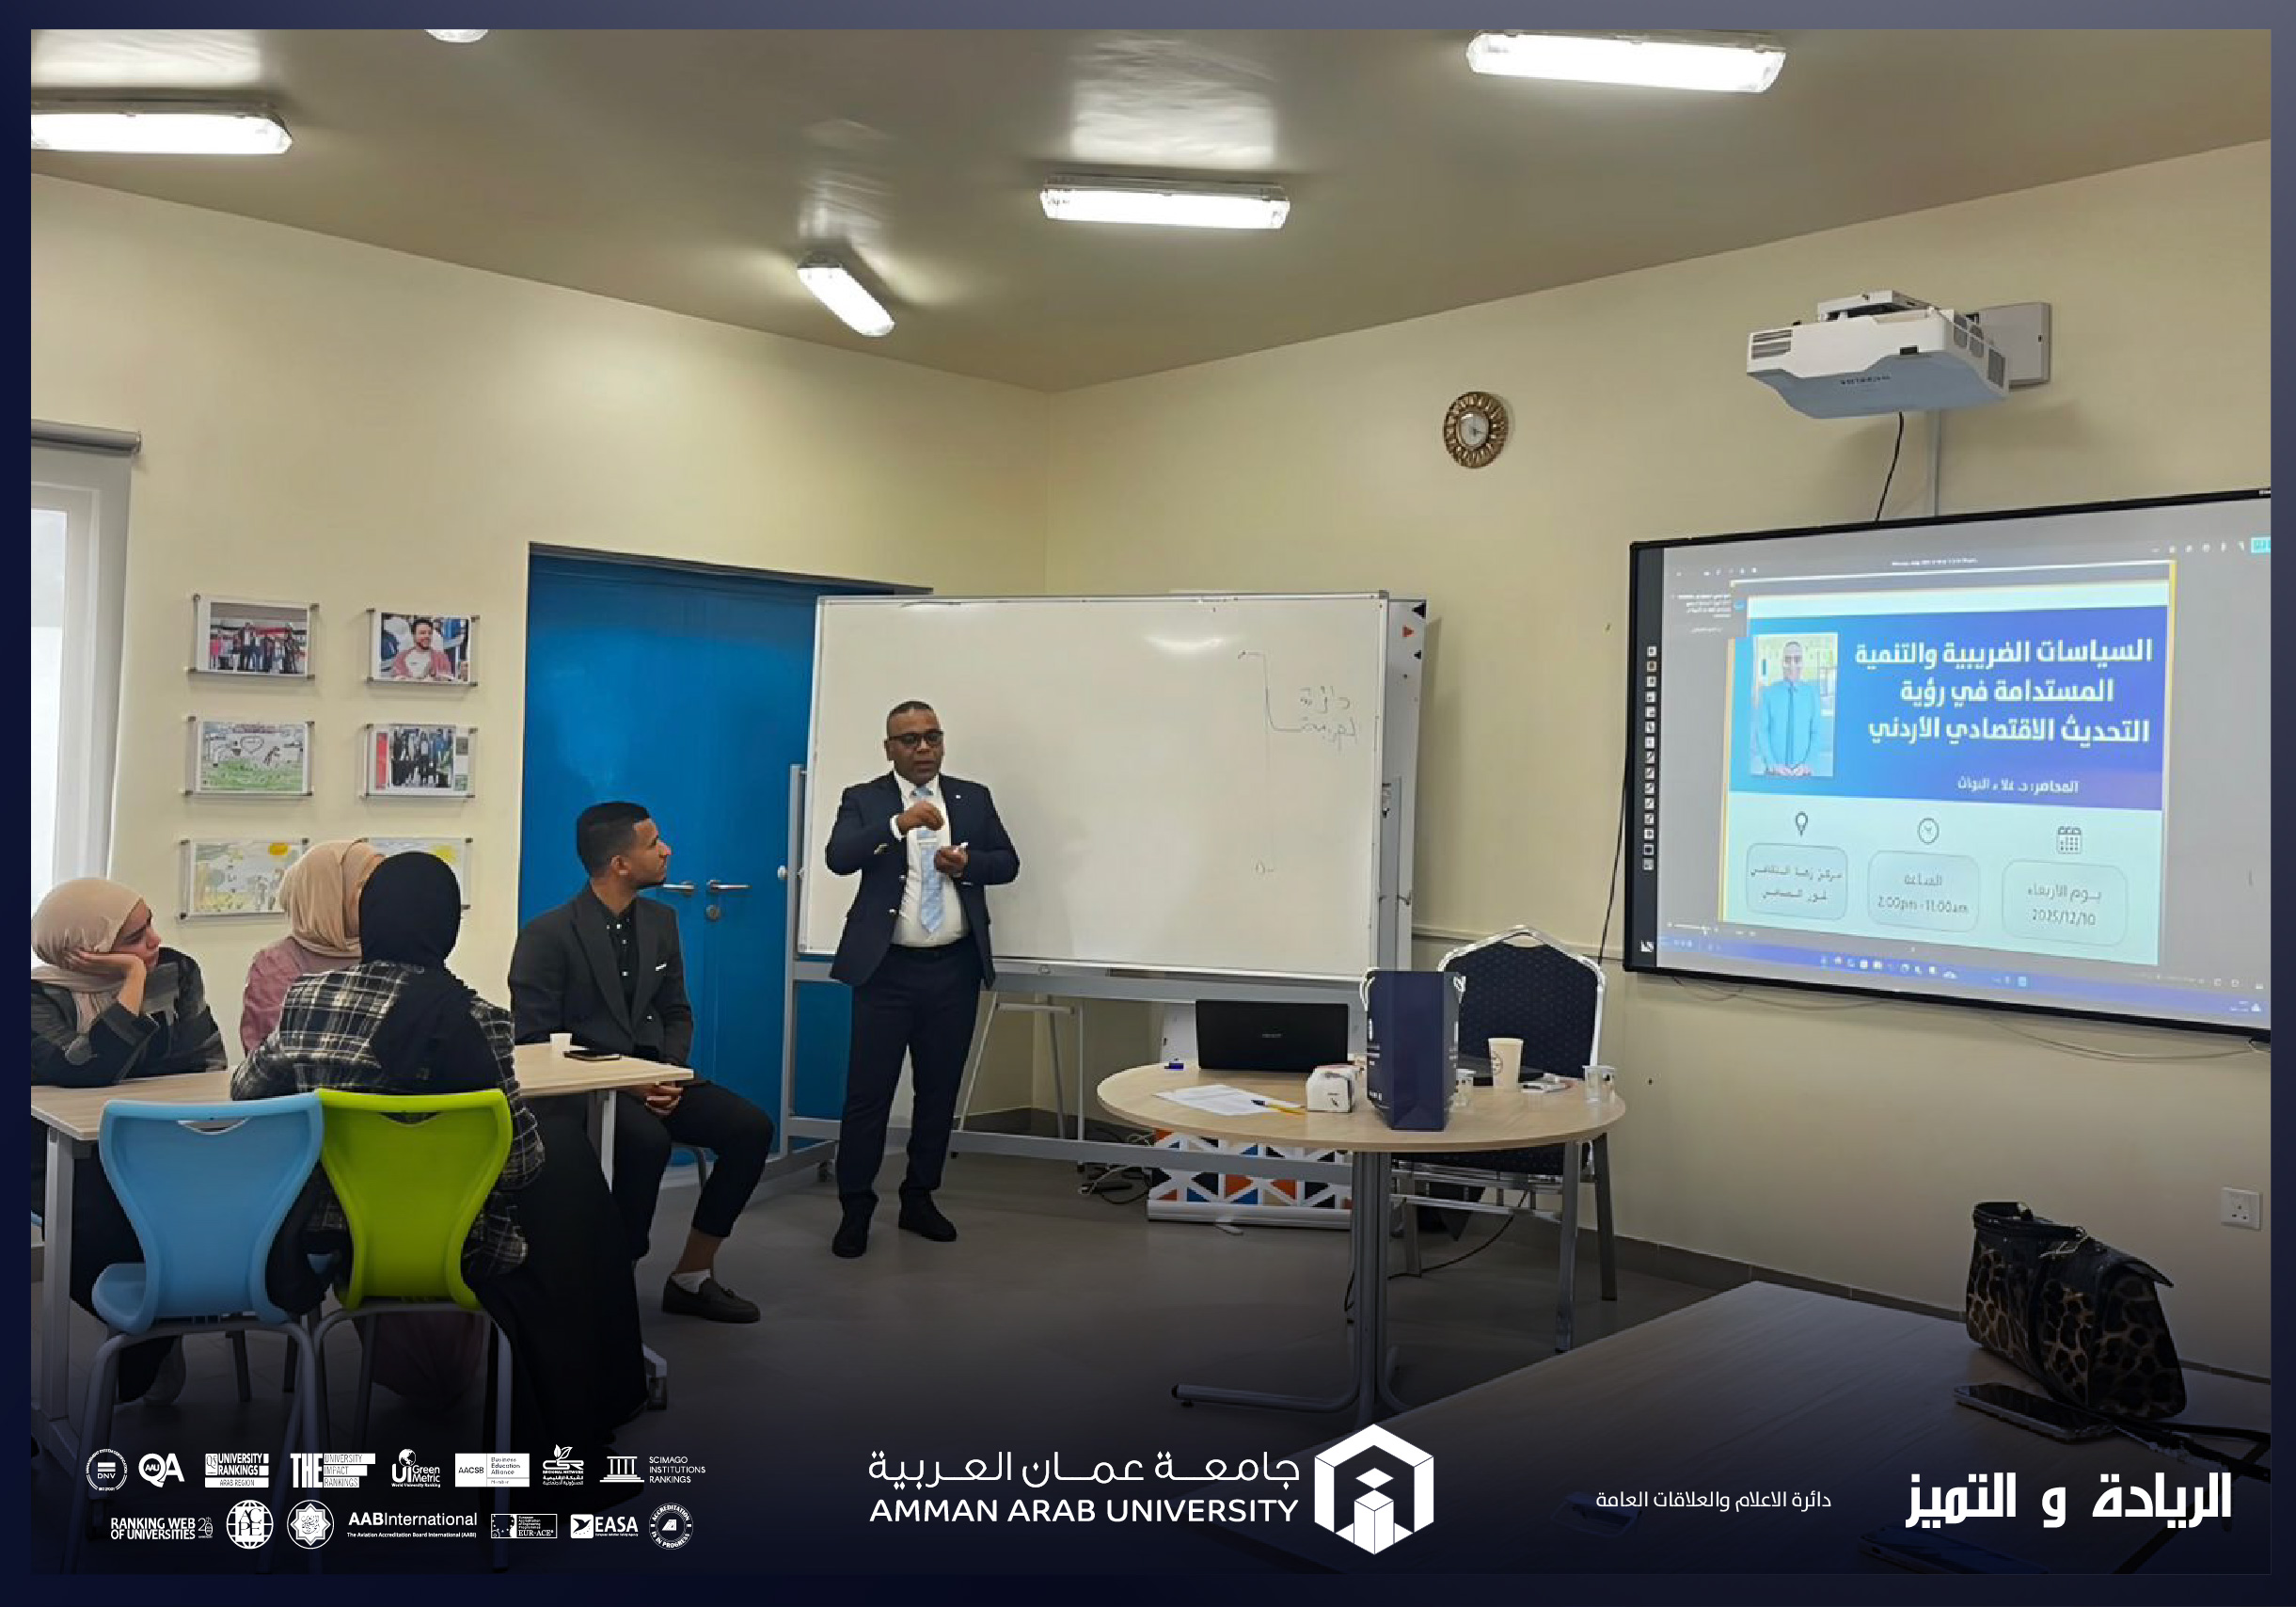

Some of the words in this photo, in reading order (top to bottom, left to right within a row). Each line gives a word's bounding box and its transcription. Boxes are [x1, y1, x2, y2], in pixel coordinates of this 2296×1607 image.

[1855, 641, 1938, 670] والتنمية
[1942, 640, 2030, 670] الضريبية
[2035, 638, 2153, 669] السياسات
[1900, 677, 1945, 708] رؤية
[1951, 678, 1988, 708] في
[1993, 676, 2114, 703] المستدامة
[1945, 716, 2054, 745] الاقتصادي
[2060, 713, 2151, 748] التحديث
[2069, 888, 2102, 904] يوم
